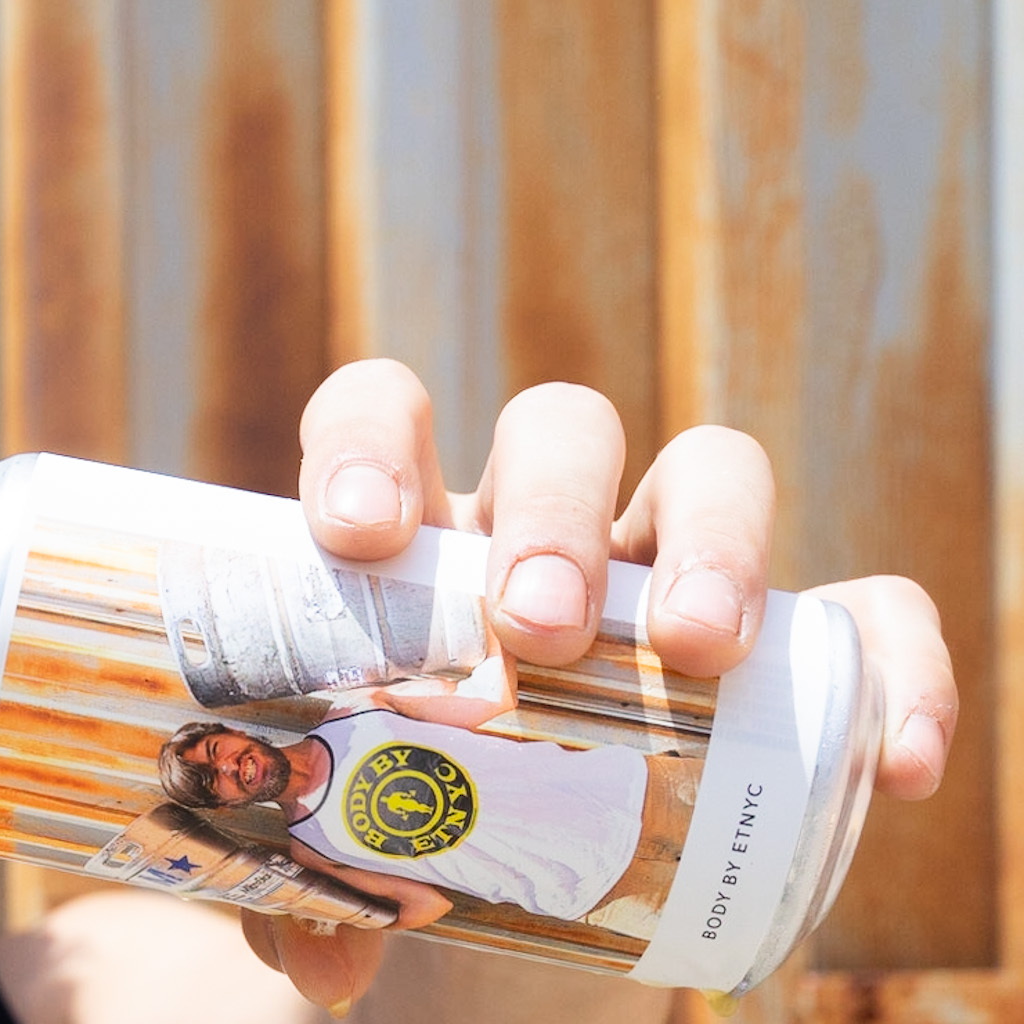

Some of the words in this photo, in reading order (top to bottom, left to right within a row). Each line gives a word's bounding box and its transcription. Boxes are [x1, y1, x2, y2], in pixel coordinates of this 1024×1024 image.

[368, 749, 412, 777] BY
[350, 772, 389, 849] BODY
[411, 762, 468, 852] ETNYC
[701, 891, 731, 940] BODY
[722, 861, 741, 885] BY
[732, 783, 763, 853] ETNYC
